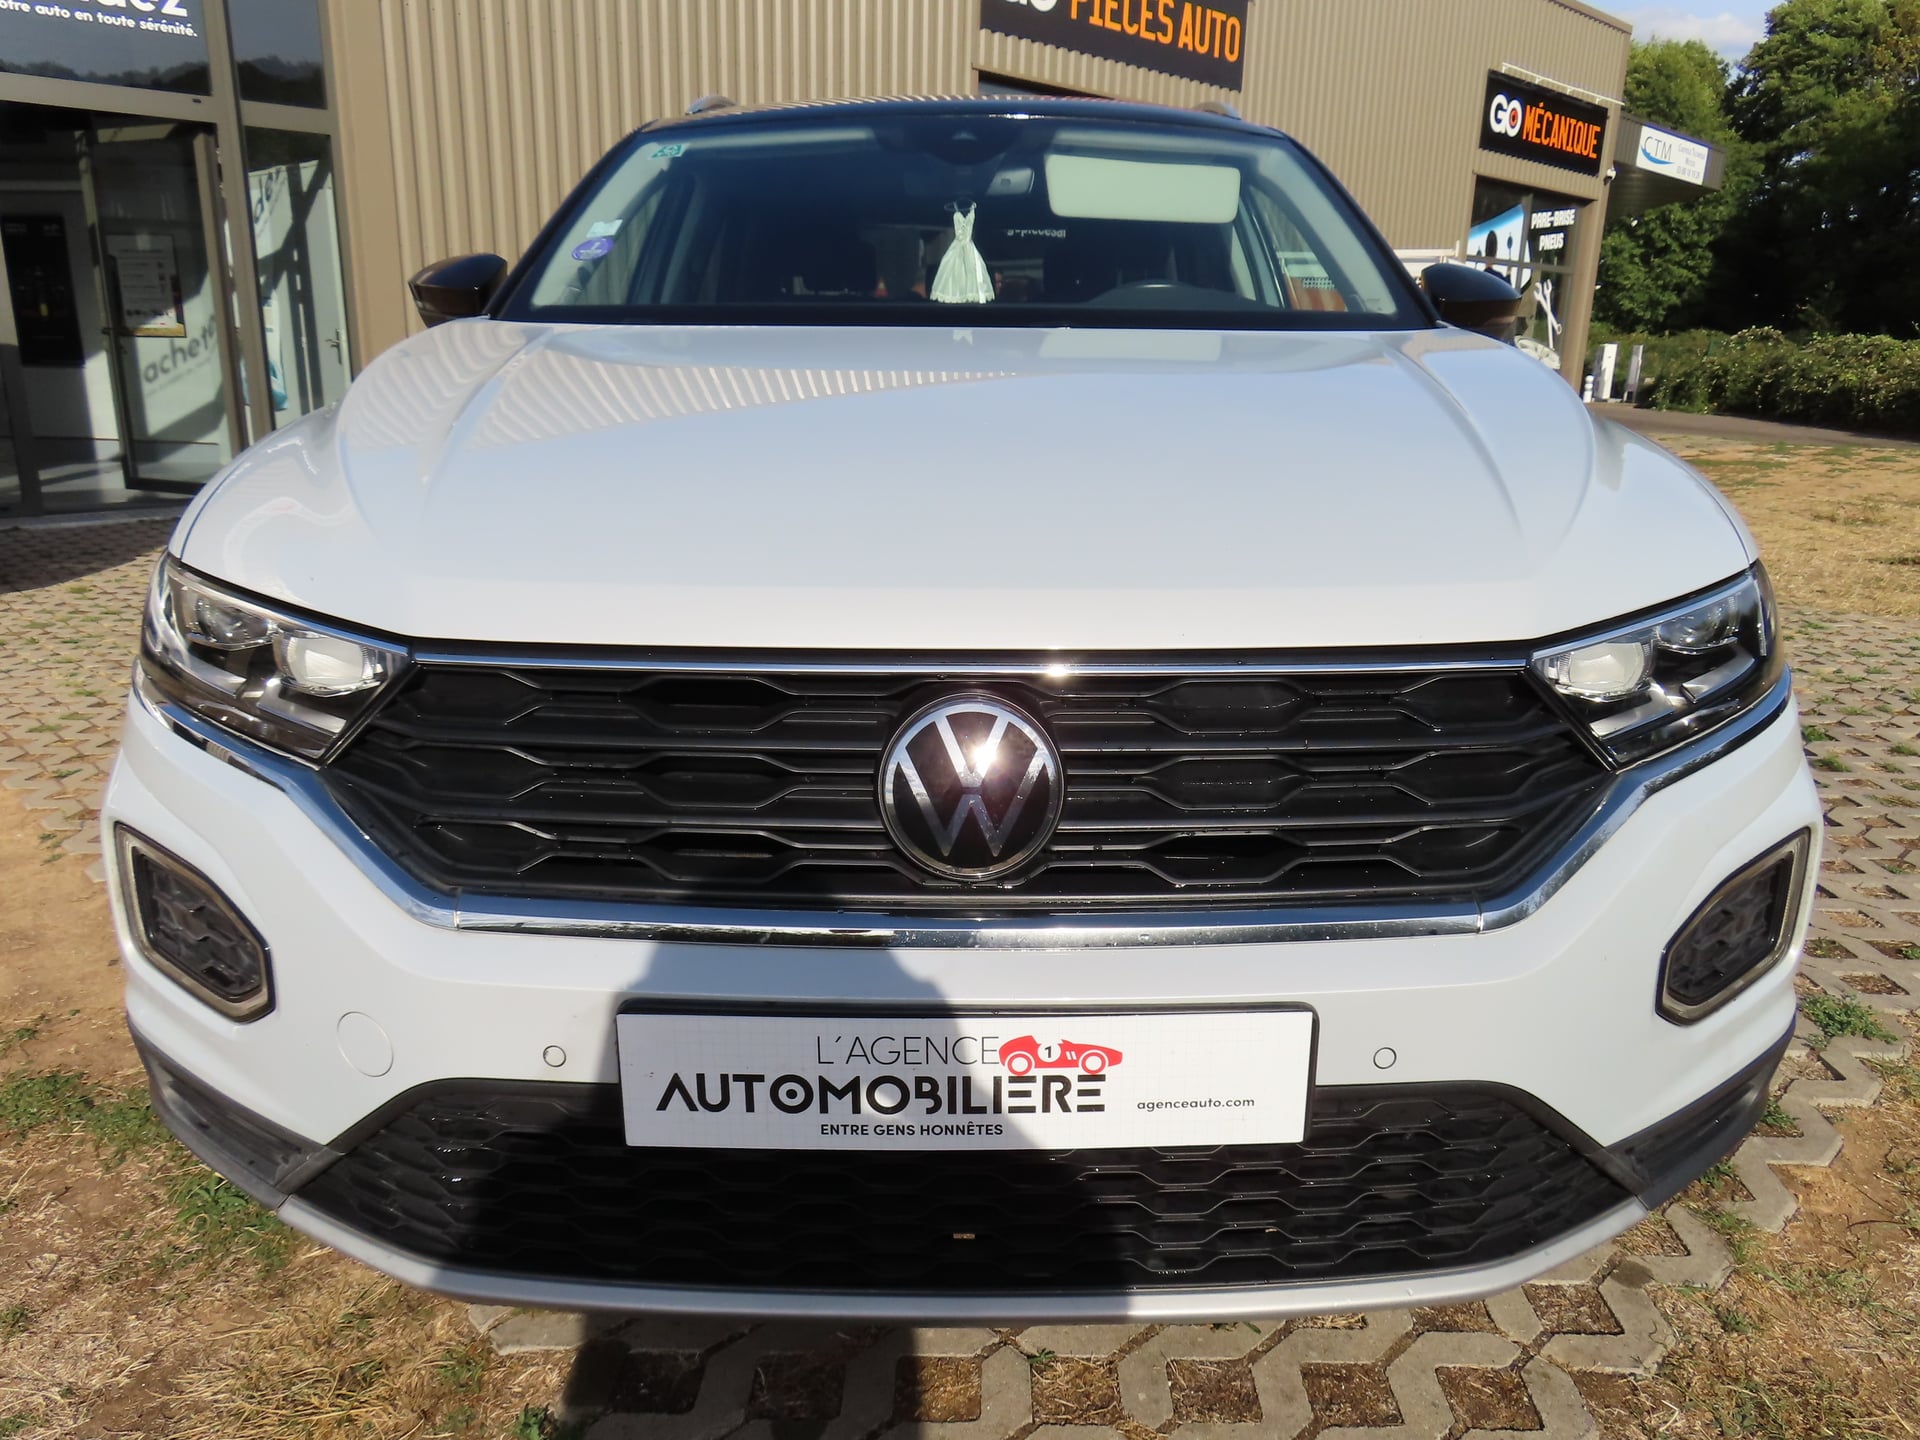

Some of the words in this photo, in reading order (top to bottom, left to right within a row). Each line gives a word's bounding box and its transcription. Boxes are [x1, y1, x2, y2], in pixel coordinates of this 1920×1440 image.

[35, 3, 71, 18] auto
[75, 10, 94, 22] en
[97, 12, 136, 28] toute
[140, 16, 198, 37] sérénité.
[1177, 2, 1242, 62] AUTO
[1489, 93, 1522, 137] GO
[1522, 102, 1601, 159] MÉCANIQUE
[1644, 136, 1672, 161] CTM
[1530, 208, 1576, 230] PARE-BRISE
[1539, 232, 1565, 251] PNEUS
[817, 1035, 1000, 1065] L'AGENCE
[1043, 1045, 1052, 1059] 1
[656, 1072, 1106, 1115] AUTOMOBILIERE
[1136, 1097, 1255, 1112] agenceauto.com
[820, 1123, 869, 1136] ENTRE
[873, 1123, 916, 1136] GENS
[920, 1120, 1003, 1136] HONNÊTES
